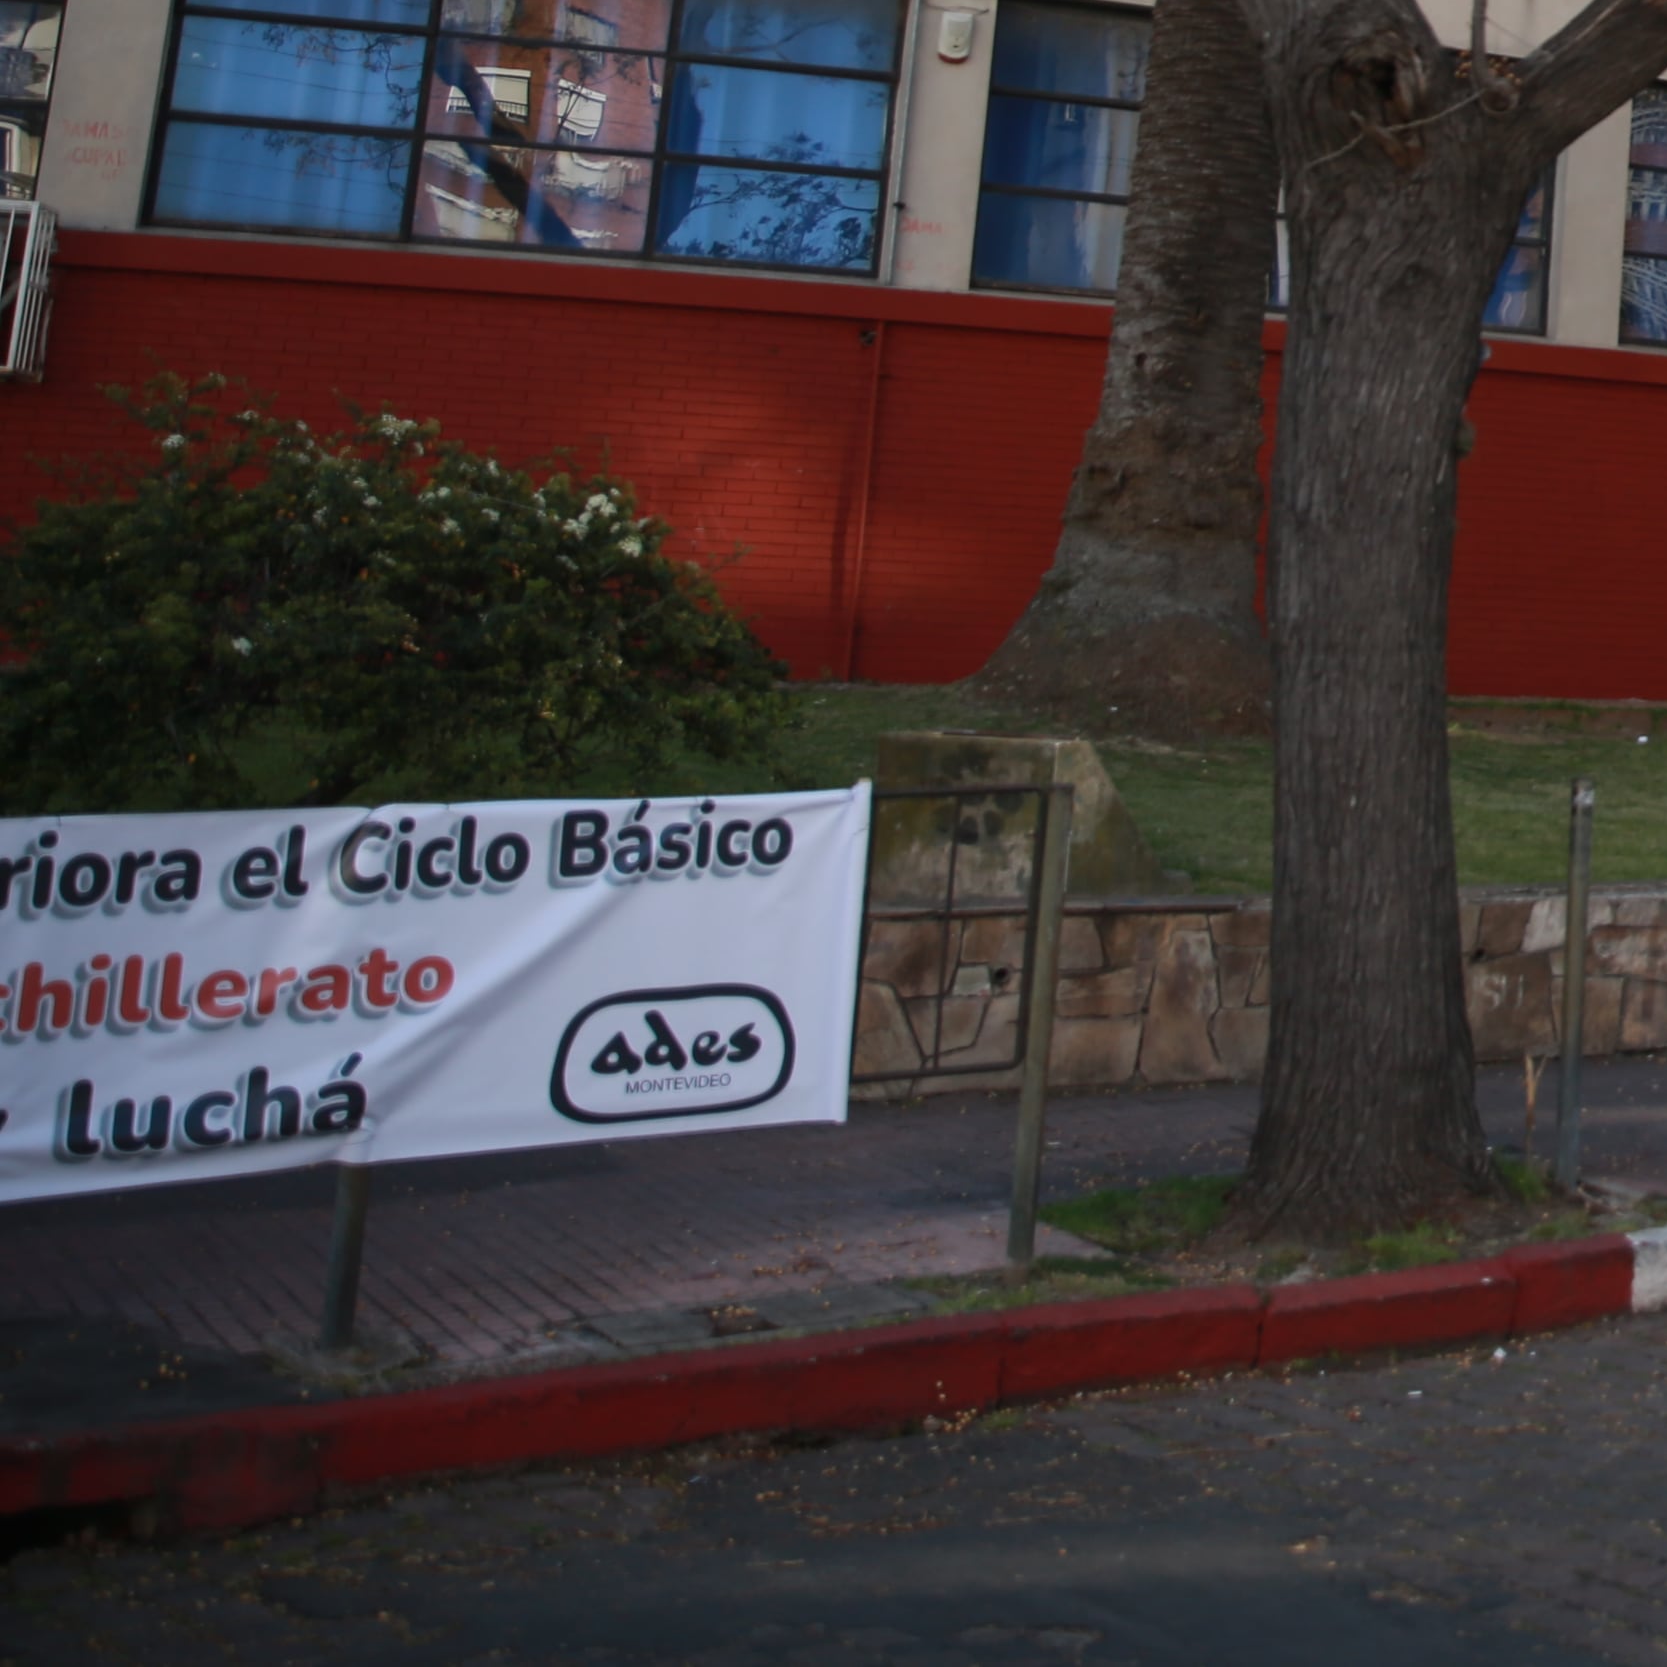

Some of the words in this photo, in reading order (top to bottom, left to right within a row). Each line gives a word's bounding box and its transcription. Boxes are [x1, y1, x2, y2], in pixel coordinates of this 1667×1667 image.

[233, 824, 309, 900] el
[340, 815, 530, 894] Ciclo
[559, 799, 794, 878] Básico
[0, 948, 455, 1032] hillerato
[591, 1009, 762, 1075] ades
[625, 1073, 732, 1095] MONTEVIDEO
[66, 1052, 368, 1155] luchá
